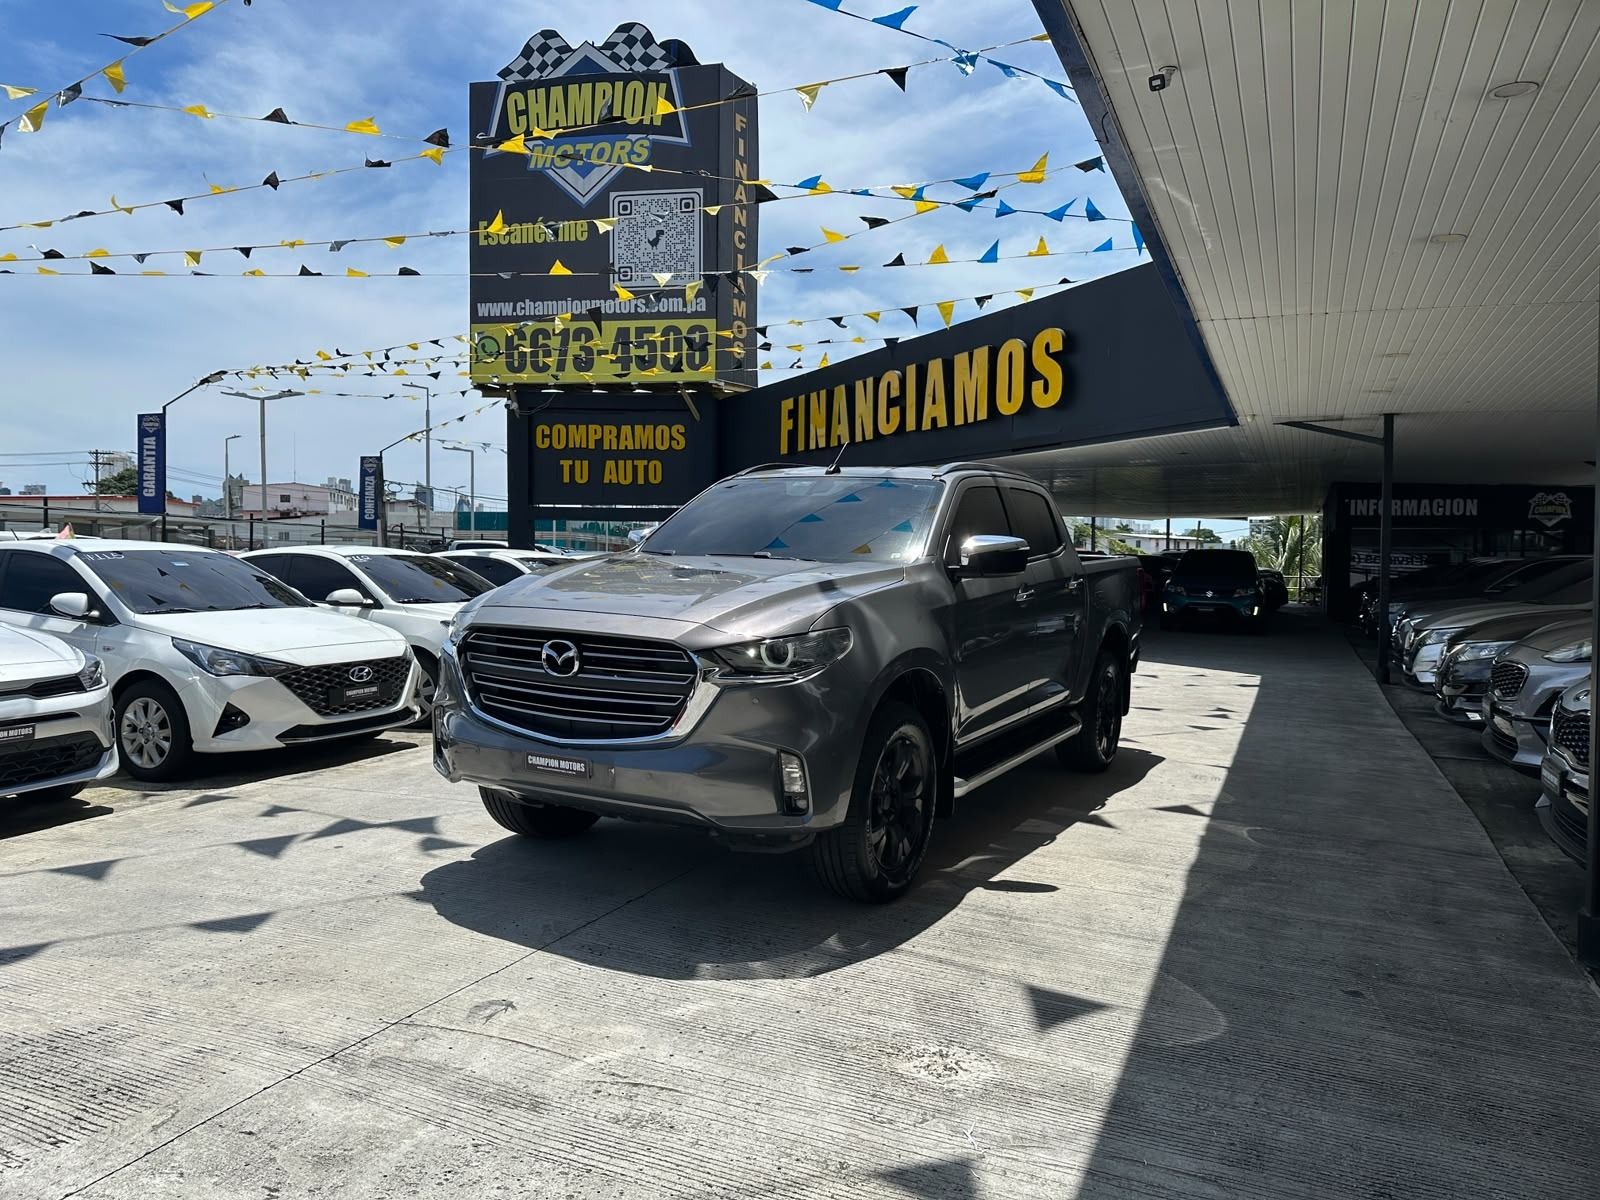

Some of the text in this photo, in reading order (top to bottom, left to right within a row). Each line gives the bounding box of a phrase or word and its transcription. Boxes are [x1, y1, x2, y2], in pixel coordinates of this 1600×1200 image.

[507, 80, 667, 135] CHAMPION
[529, 138, 650, 169] MOTORS
[780, 327, 1064, 455] FINANCIAMOS
[535, 423, 687, 451] COMPRAMOS
[142, 436, 156, 497] GARANTIA
[559, 459, 663, 485] TU AUTO
[364, 475, 375, 520] CONFIANZA
[527, 755, 559, 768] CHAMPION
[559, 760, 586, 772] MOTORS
